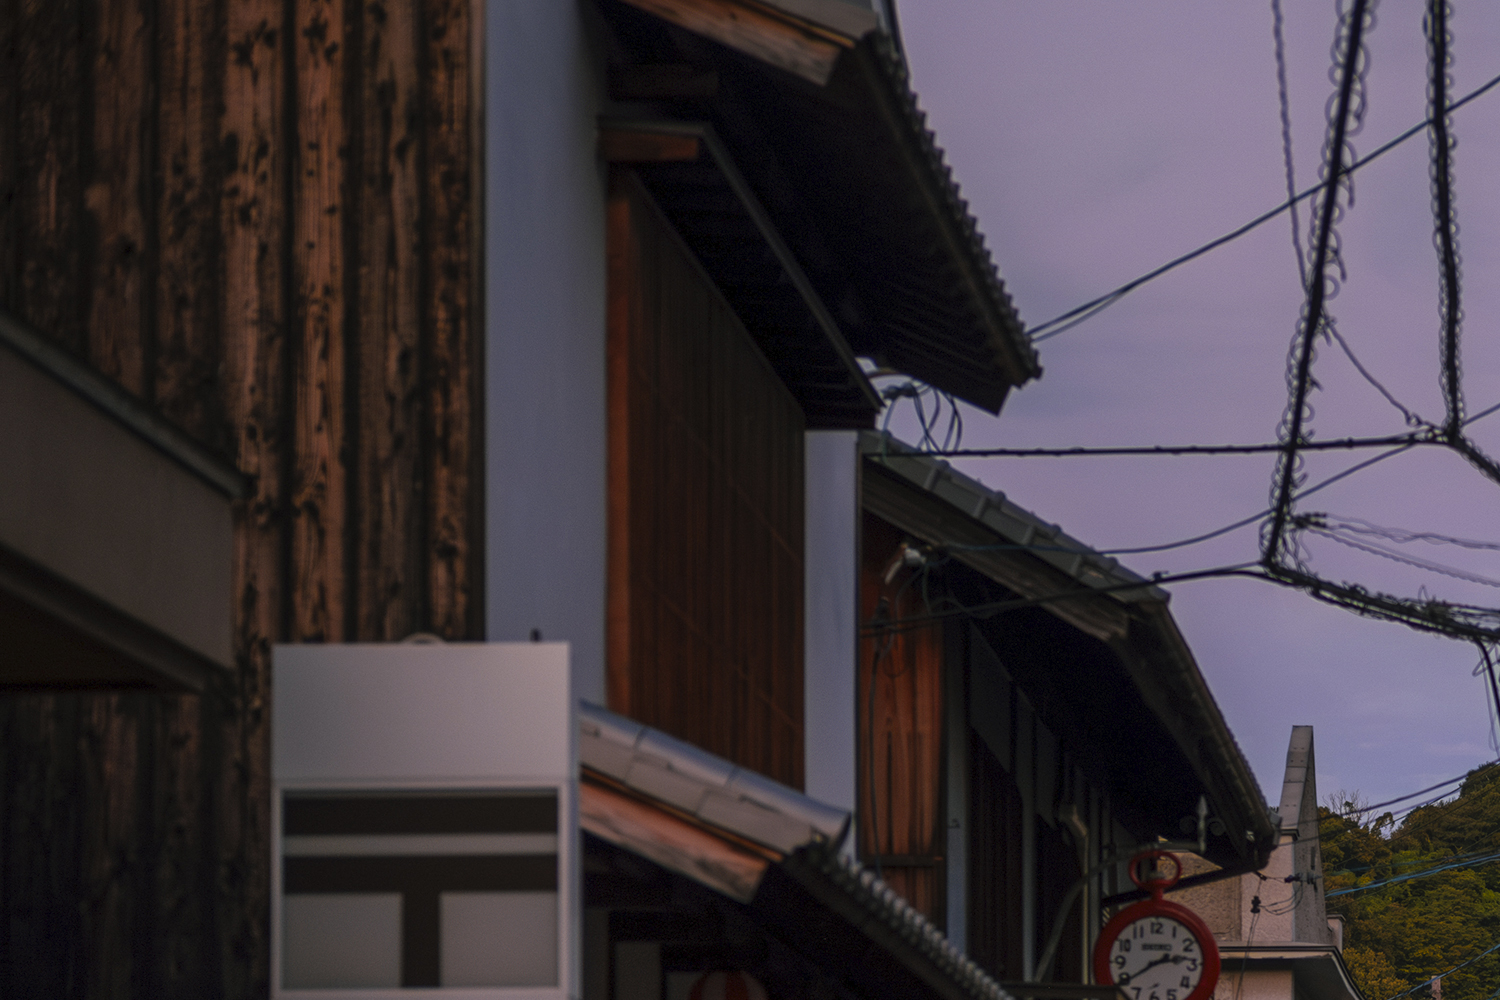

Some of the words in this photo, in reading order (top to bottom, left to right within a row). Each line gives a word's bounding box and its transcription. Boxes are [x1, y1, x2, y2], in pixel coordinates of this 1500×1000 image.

[1133, 925, 1144, 939] 11
[1151, 922, 1163, 934] 12
[1172, 926, 1177, 938] 1
[1119, 939, 1131, 952] 10
[1183, 938, 1195, 952] 2
[1115, 955, 1126, 969] 9
[1186, 958, 1198, 972] 3
[1118, 972, 1131, 986] 8
[1181, 976, 1190, 989] 4
[1131, 987, 1142, 1000] 7
